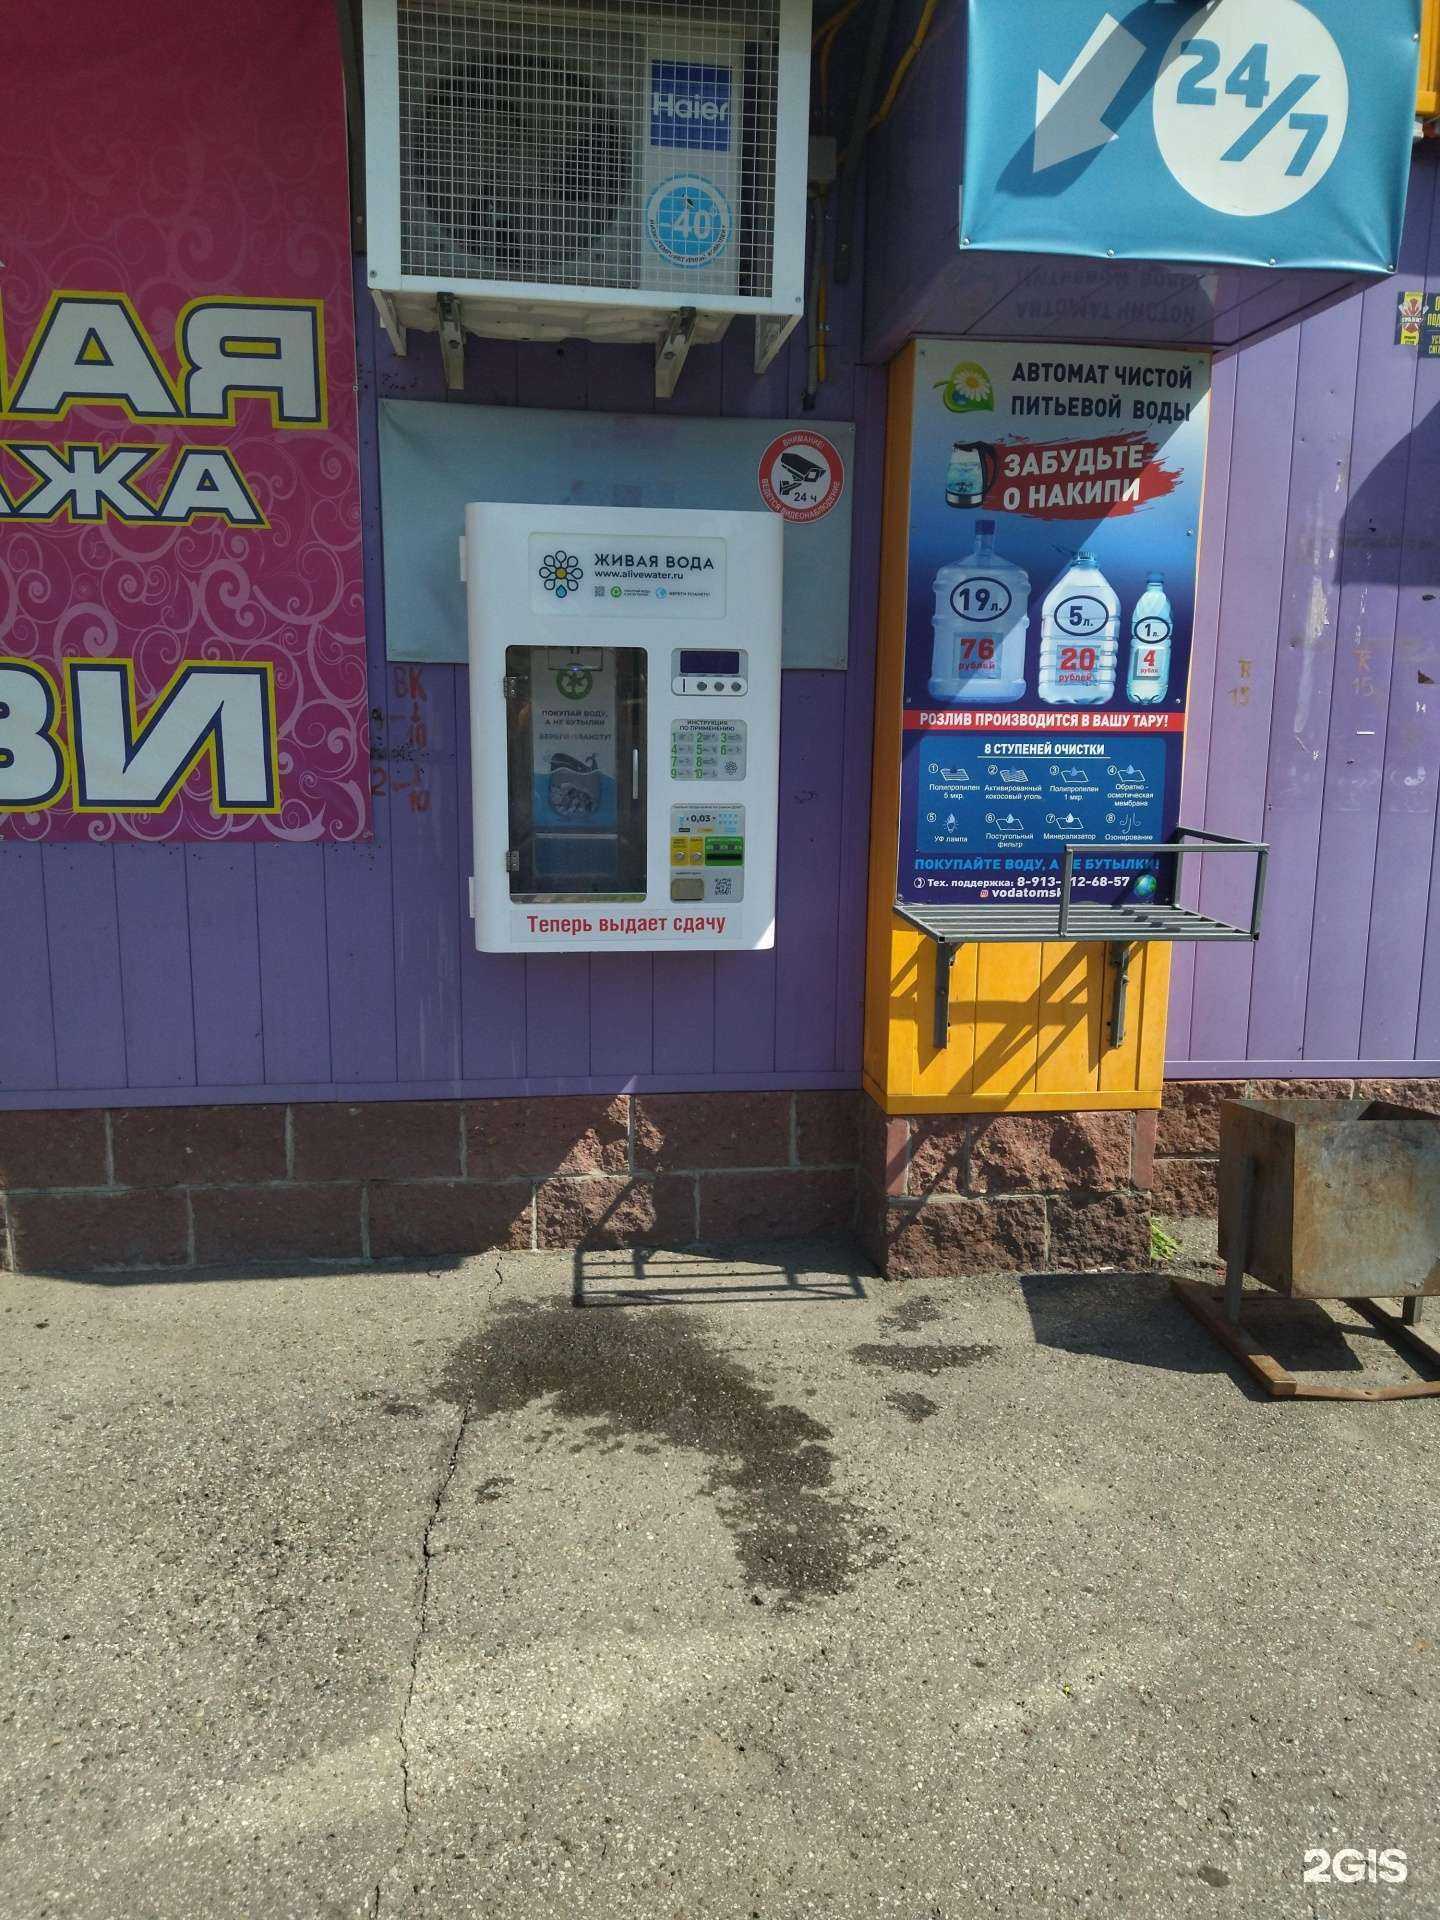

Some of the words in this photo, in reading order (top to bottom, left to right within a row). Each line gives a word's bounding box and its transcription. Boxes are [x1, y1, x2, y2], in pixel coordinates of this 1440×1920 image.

[652, 92, 729, 121] Haier
[1176, 39, 1329, 177] 24/7
[0, 290, 328, 428] АЯ
[1012, 361, 1109, 386] АВТОМАТ
[1115, 365, 1192, 389] ЧИСТОЙ
[1011, 394, 1121, 418] ПИТЬЕВОЙ
[1132, 400, 1190, 423] ВОДЫ
[1003, 444, 1145, 478] ЗАБУДЬТЕ
[0, 440, 272, 529] ЖА
[793, 492, 807, 502] 24
[1003, 487, 1021, 510] О
[1028, 477, 1141, 508] НАКИПИ
[594, 553, 659, 569] ЖИВАЯ
[666, 555, 715, 571] ВОДА
[594, 570, 684, 581] www.alivewater.ru
[960, 638, 995, 660] 76
[958, 661, 996, 673] рублей
[1060, 648, 1096, 671] 20
[1143, 650, 1155, 667] 4
[1058, 672, 1093, 684] рублей
[920, 712, 972, 726] РОЗЛИВ
[975, 713, 1079, 729] ПРОИЗВОДИТСЯ
[1082, 715, 1091, 727] В
[1093, 715, 1130, 728] ВАШУ
[1133, 715, 1168, 728] ТАРУ!
[984, 743, 991, 754] 8
[993, 741, 1052, 754] СТУПЕНЕЙ
[1054, 744, 1105, 755] ОЧИСТКИ
[929, 783, 980, 792] Полипропилен
[984, 784, 1042, 792] Активированный
[1049, 785, 1099, 793] Полипропилен
[985, 832, 1034, 840] Постугольный
[1104, 833, 1153, 841] Озонирование
[915, 856, 1001, 870] ПОКУПАЙТЕ
[1005, 859, 1046, 871] ВОДУ,
[1049, 859, 1060, 869] А
[927, 878, 949, 887] Тех.
[951, 879, 1014, 888] поддержка:
[1017, 876, 1130, 887] 8-913-12-68-57
[526, 915, 592, 935] Теперь
[599, 917, 667, 934] выдает
[673, 916, 726, 934] сдачу
